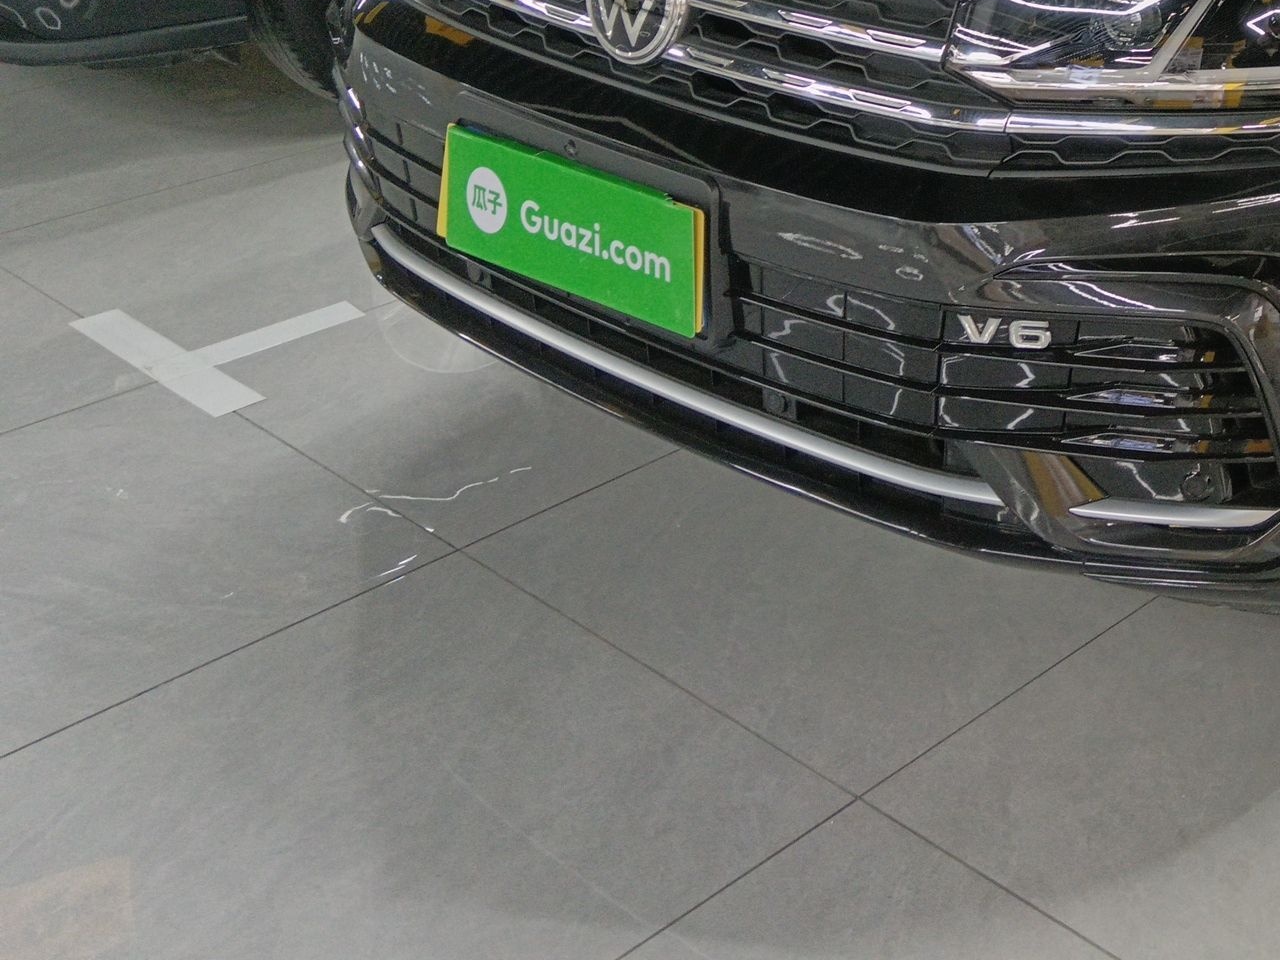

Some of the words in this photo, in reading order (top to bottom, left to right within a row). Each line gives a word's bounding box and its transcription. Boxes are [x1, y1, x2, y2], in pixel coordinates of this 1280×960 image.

[471, 183, 503, 216] 瓜子
[520, 199, 672, 283] Guazi.com
[957, 314, 1052, 349] V6
